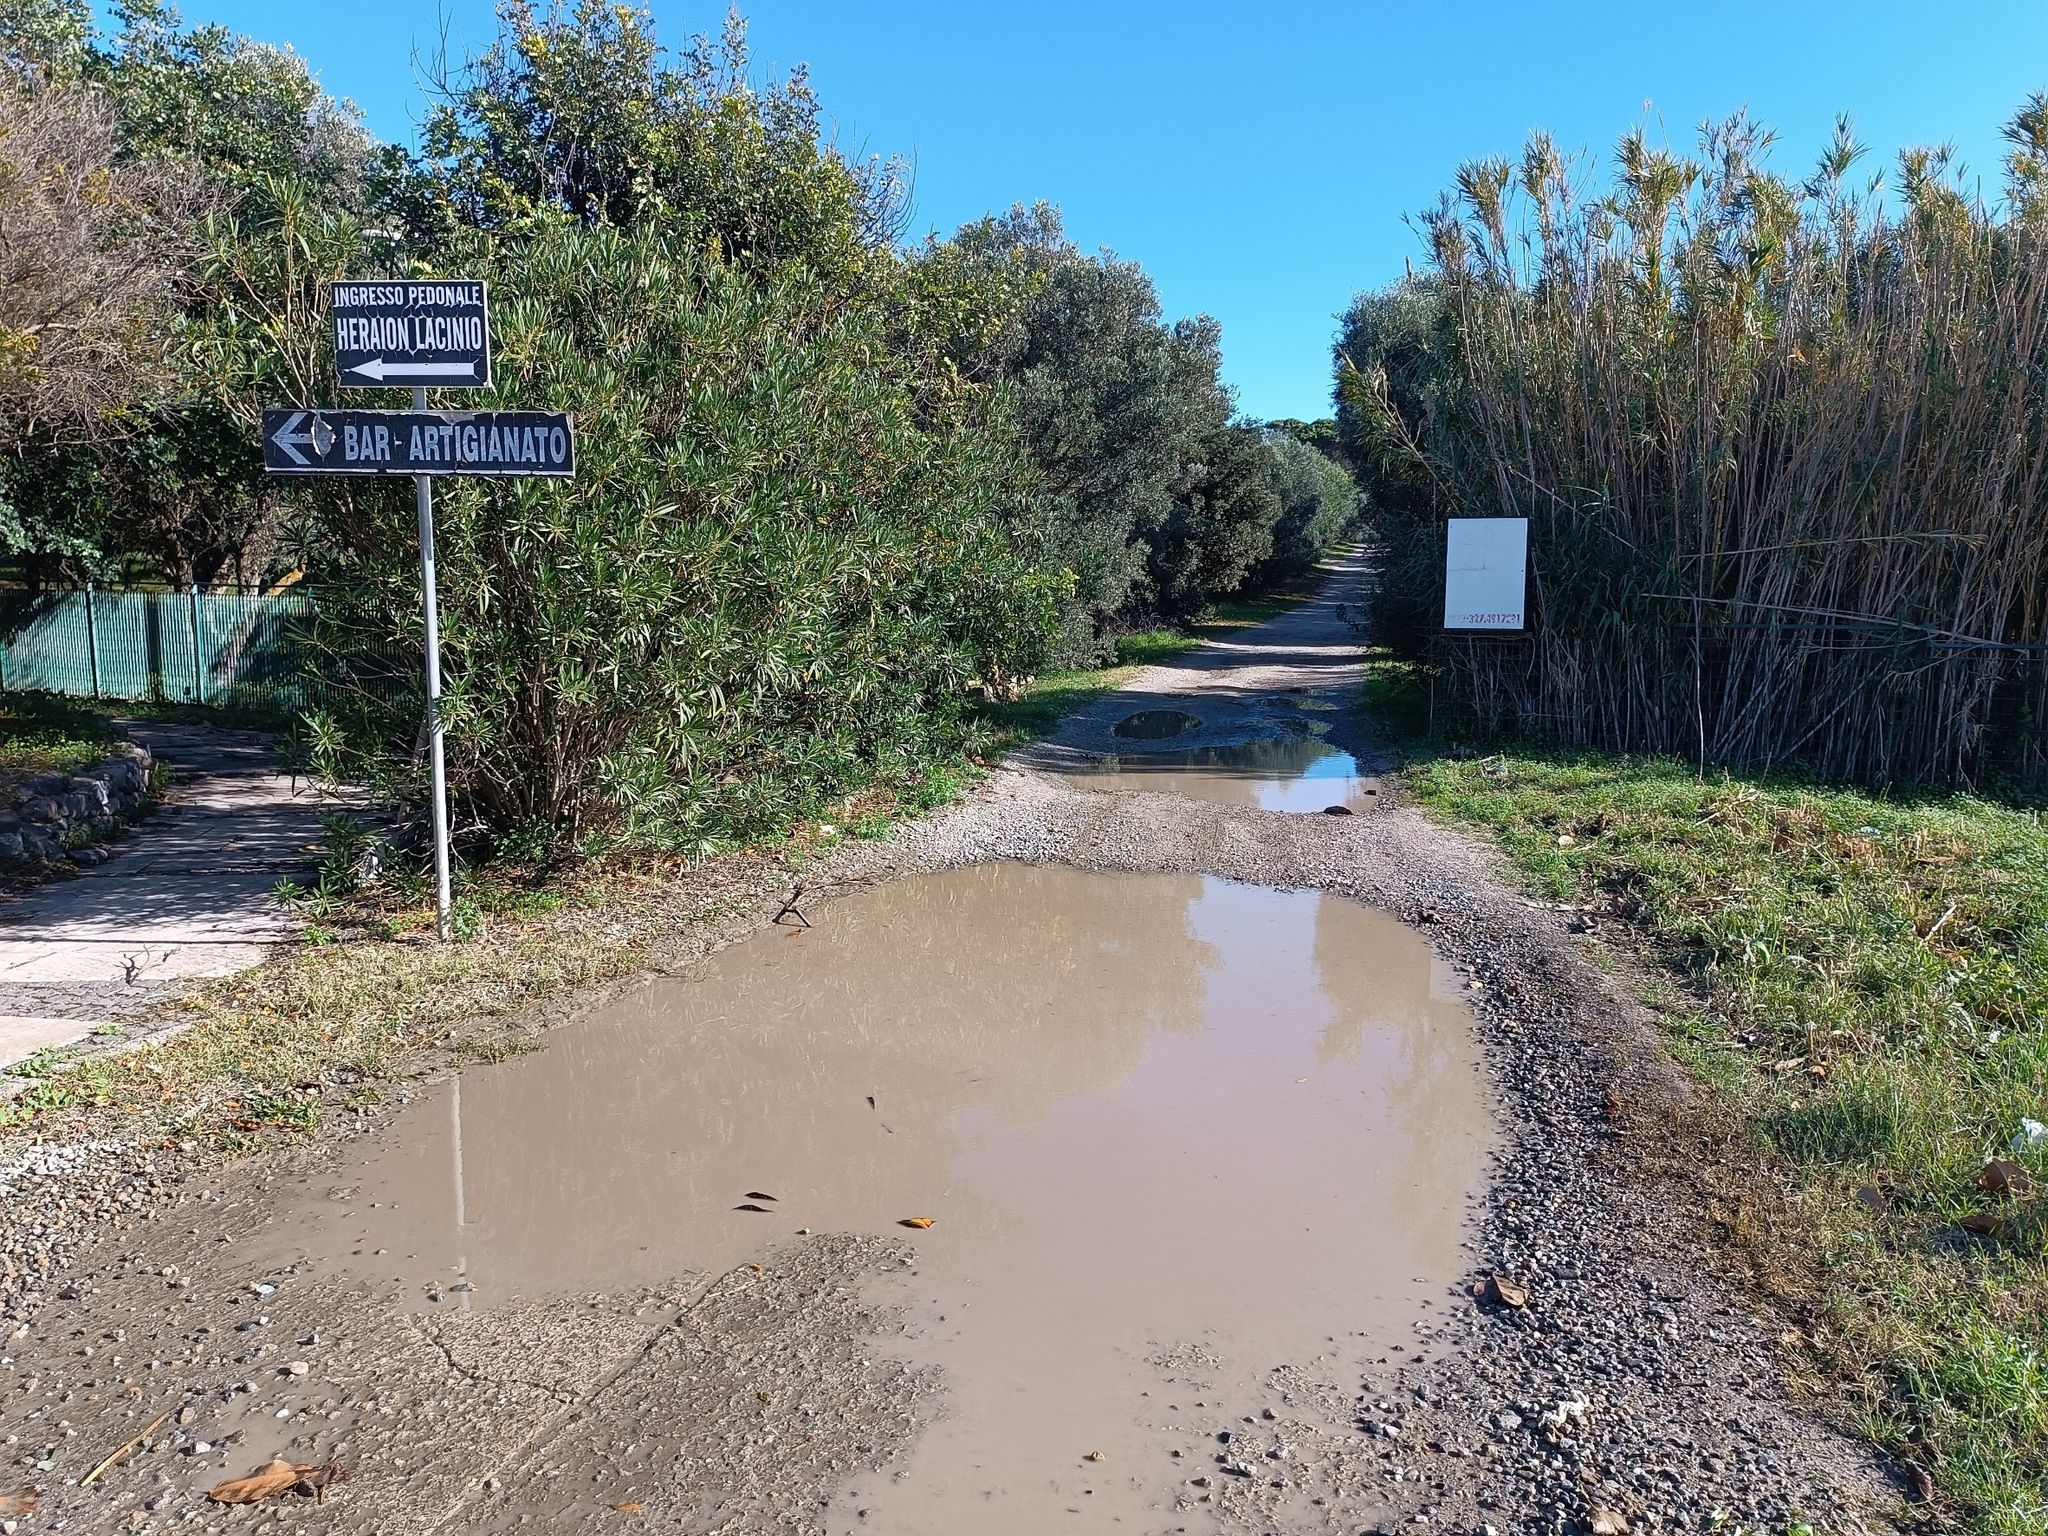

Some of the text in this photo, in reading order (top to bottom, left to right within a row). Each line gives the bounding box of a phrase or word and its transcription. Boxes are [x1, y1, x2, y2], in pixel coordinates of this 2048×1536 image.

[334, 286, 480, 306] INGRESSO PEDONALE
[337, 317, 482, 350] HERAION LACINIO
[410, 425, 567, 463] ARTIGIANATO
